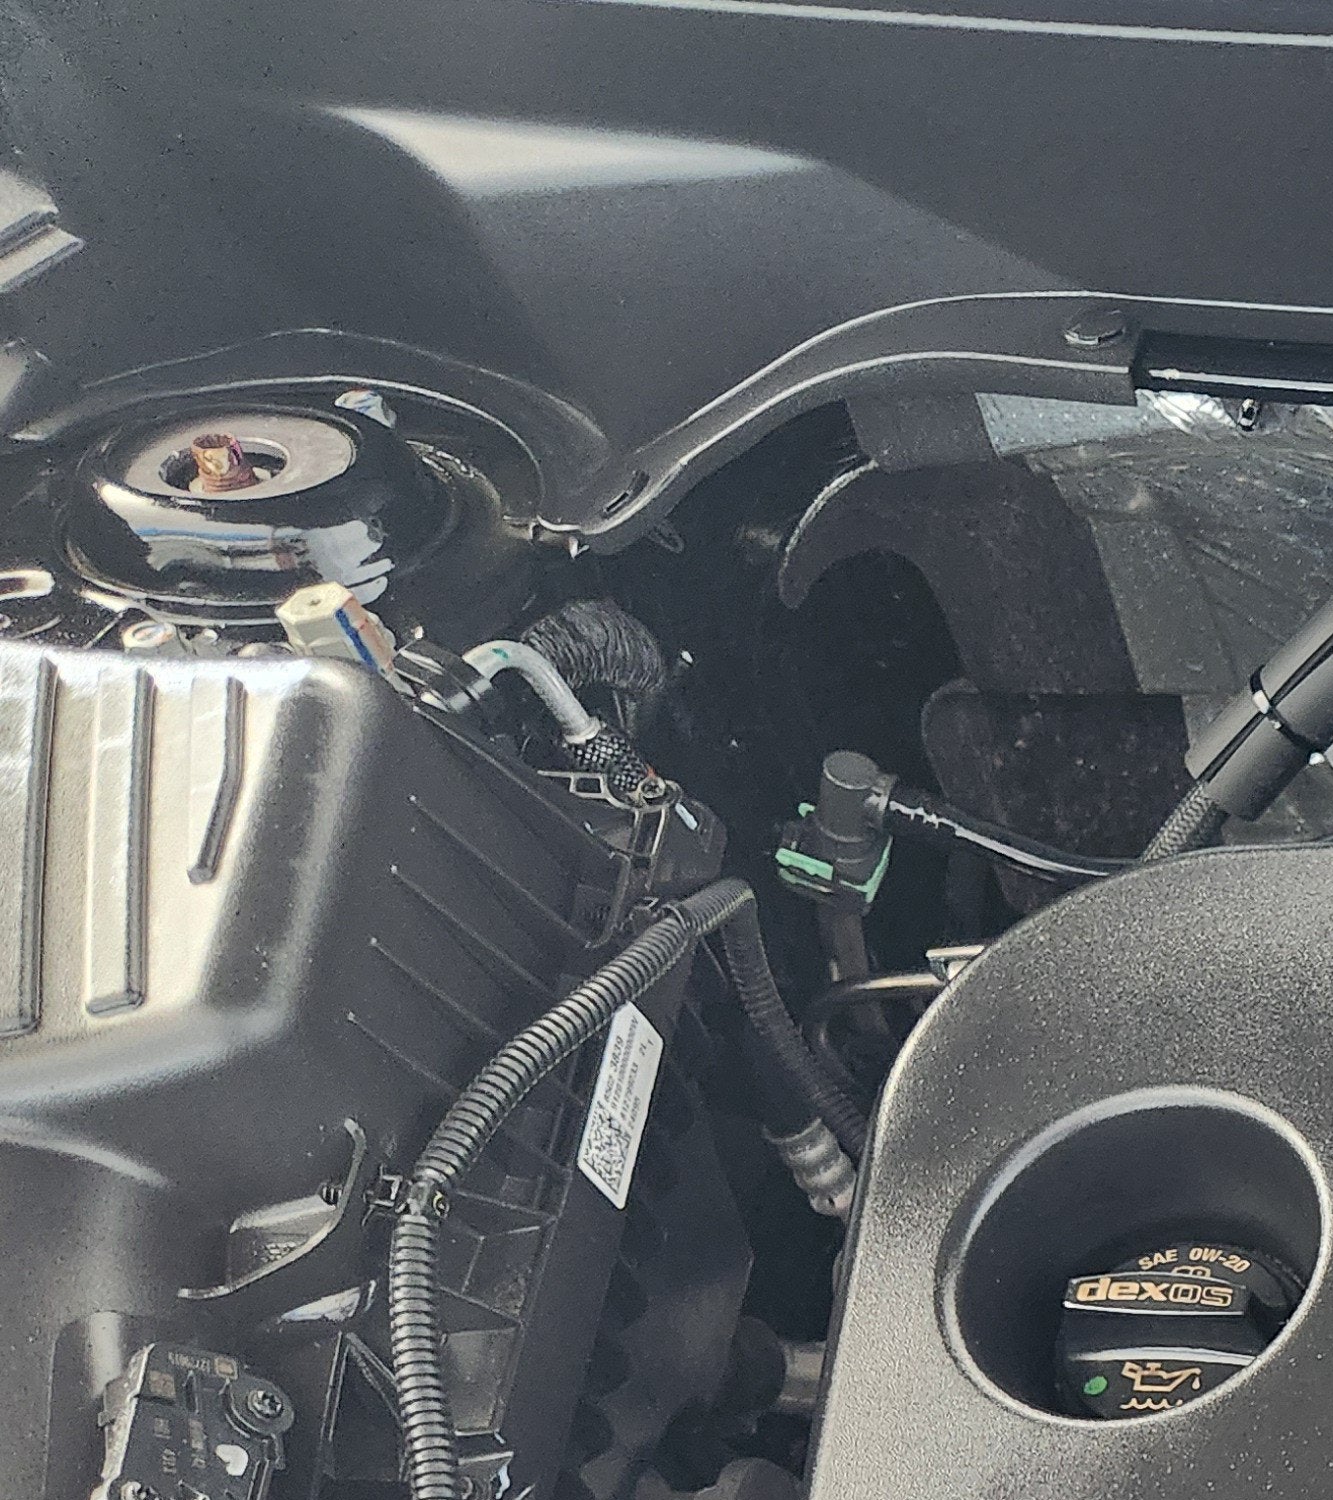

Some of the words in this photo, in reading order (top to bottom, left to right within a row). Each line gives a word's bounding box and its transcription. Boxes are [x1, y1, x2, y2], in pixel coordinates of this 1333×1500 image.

[1138, 1249, 1178, 1270] SAE
[1188, 1248, 1250, 1273] 0W-20
[1076, 1278, 1234, 1307] dexos
